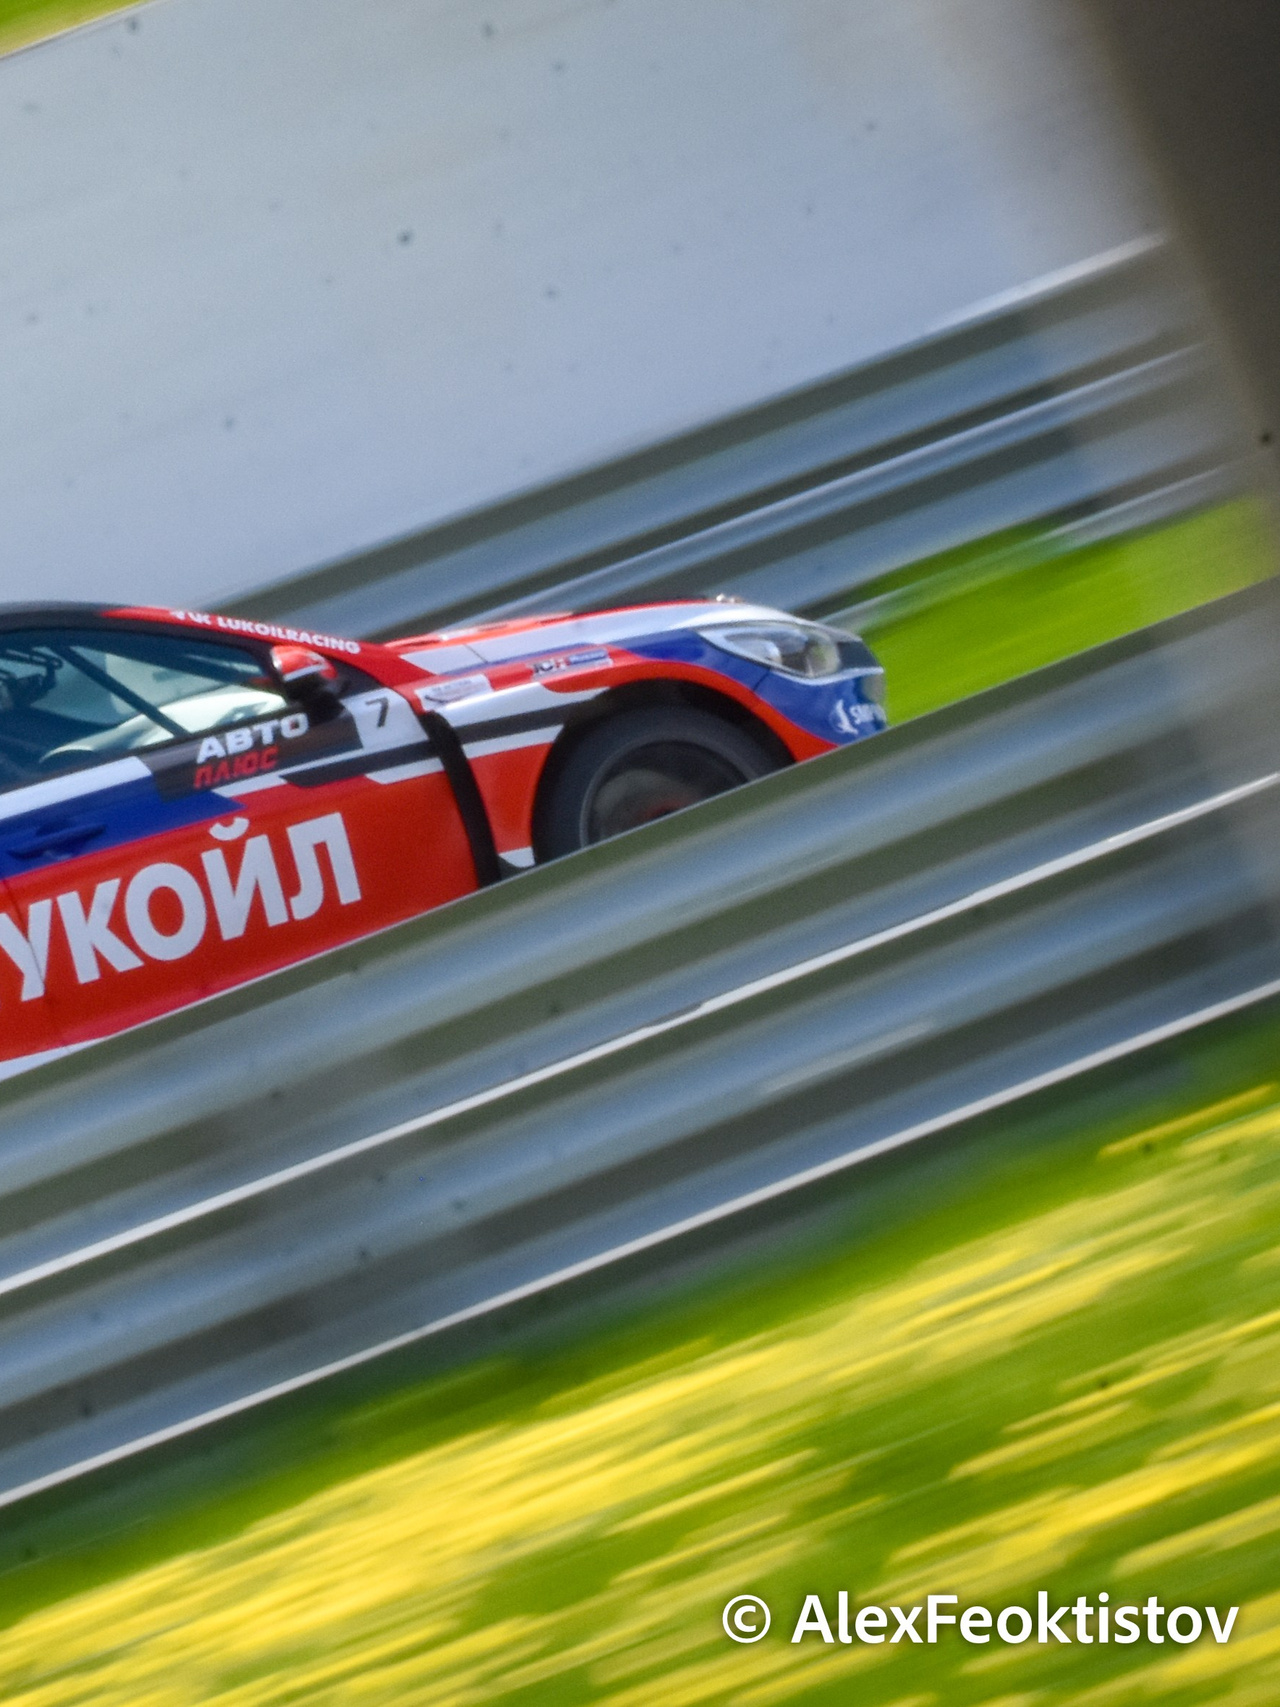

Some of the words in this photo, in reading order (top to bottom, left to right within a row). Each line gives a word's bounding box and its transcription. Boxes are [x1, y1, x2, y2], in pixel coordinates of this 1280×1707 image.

[365, 697, 389, 728] 7
[196, 712, 309, 764] АВТО
[193, 746, 279, 789] ПЛЮС
